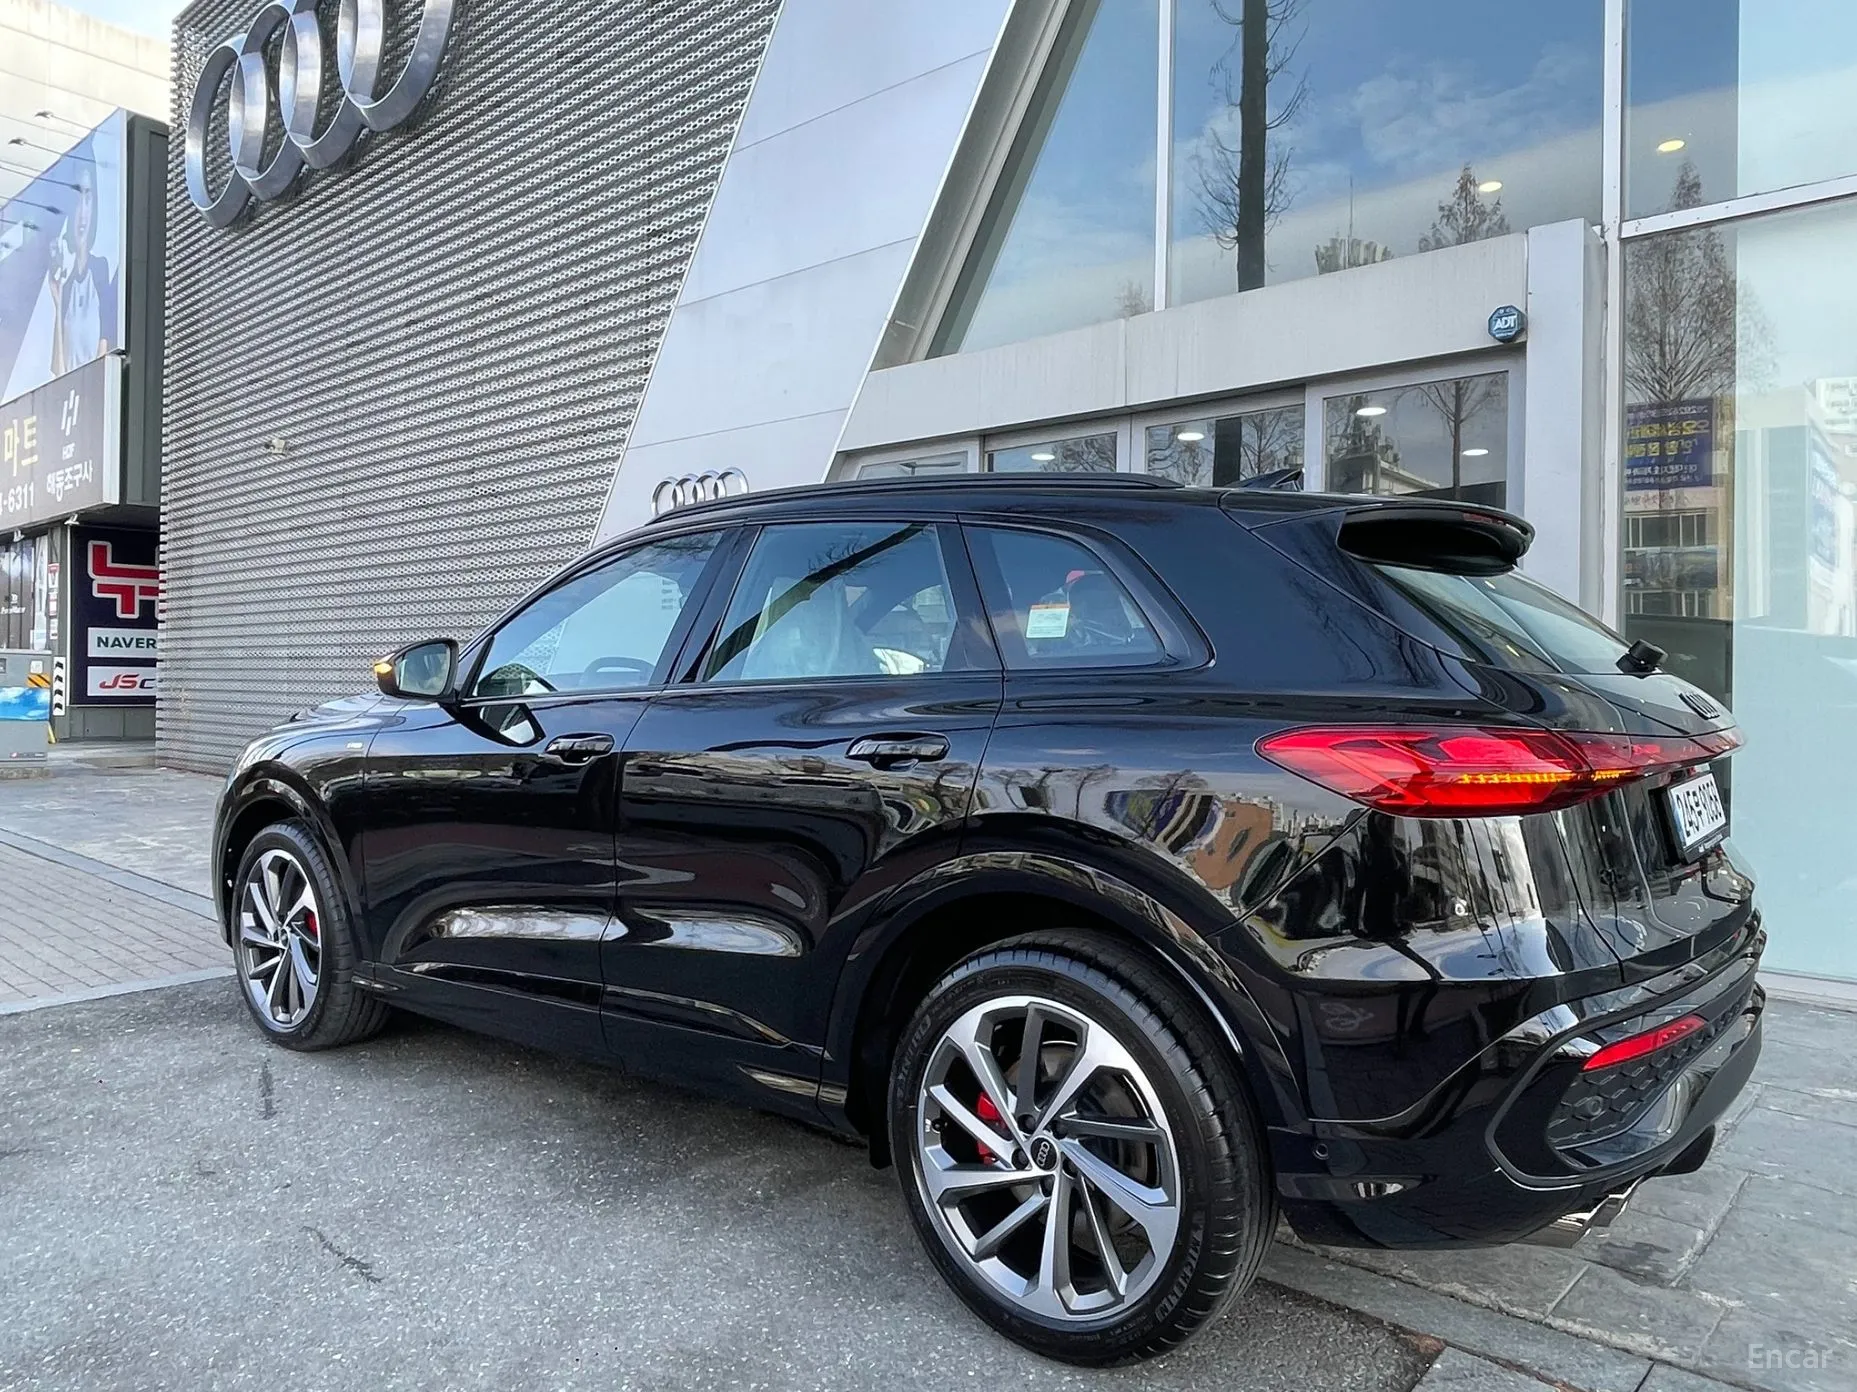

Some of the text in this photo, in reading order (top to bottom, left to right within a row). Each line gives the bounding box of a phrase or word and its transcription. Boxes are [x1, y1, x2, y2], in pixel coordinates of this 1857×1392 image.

[1494, 315, 1517, 330] ADT
[4, 415, 39, 477] 마트
[47, 459, 94, 502] 해동조구사
[97, 636, 158, 649] NAVER
